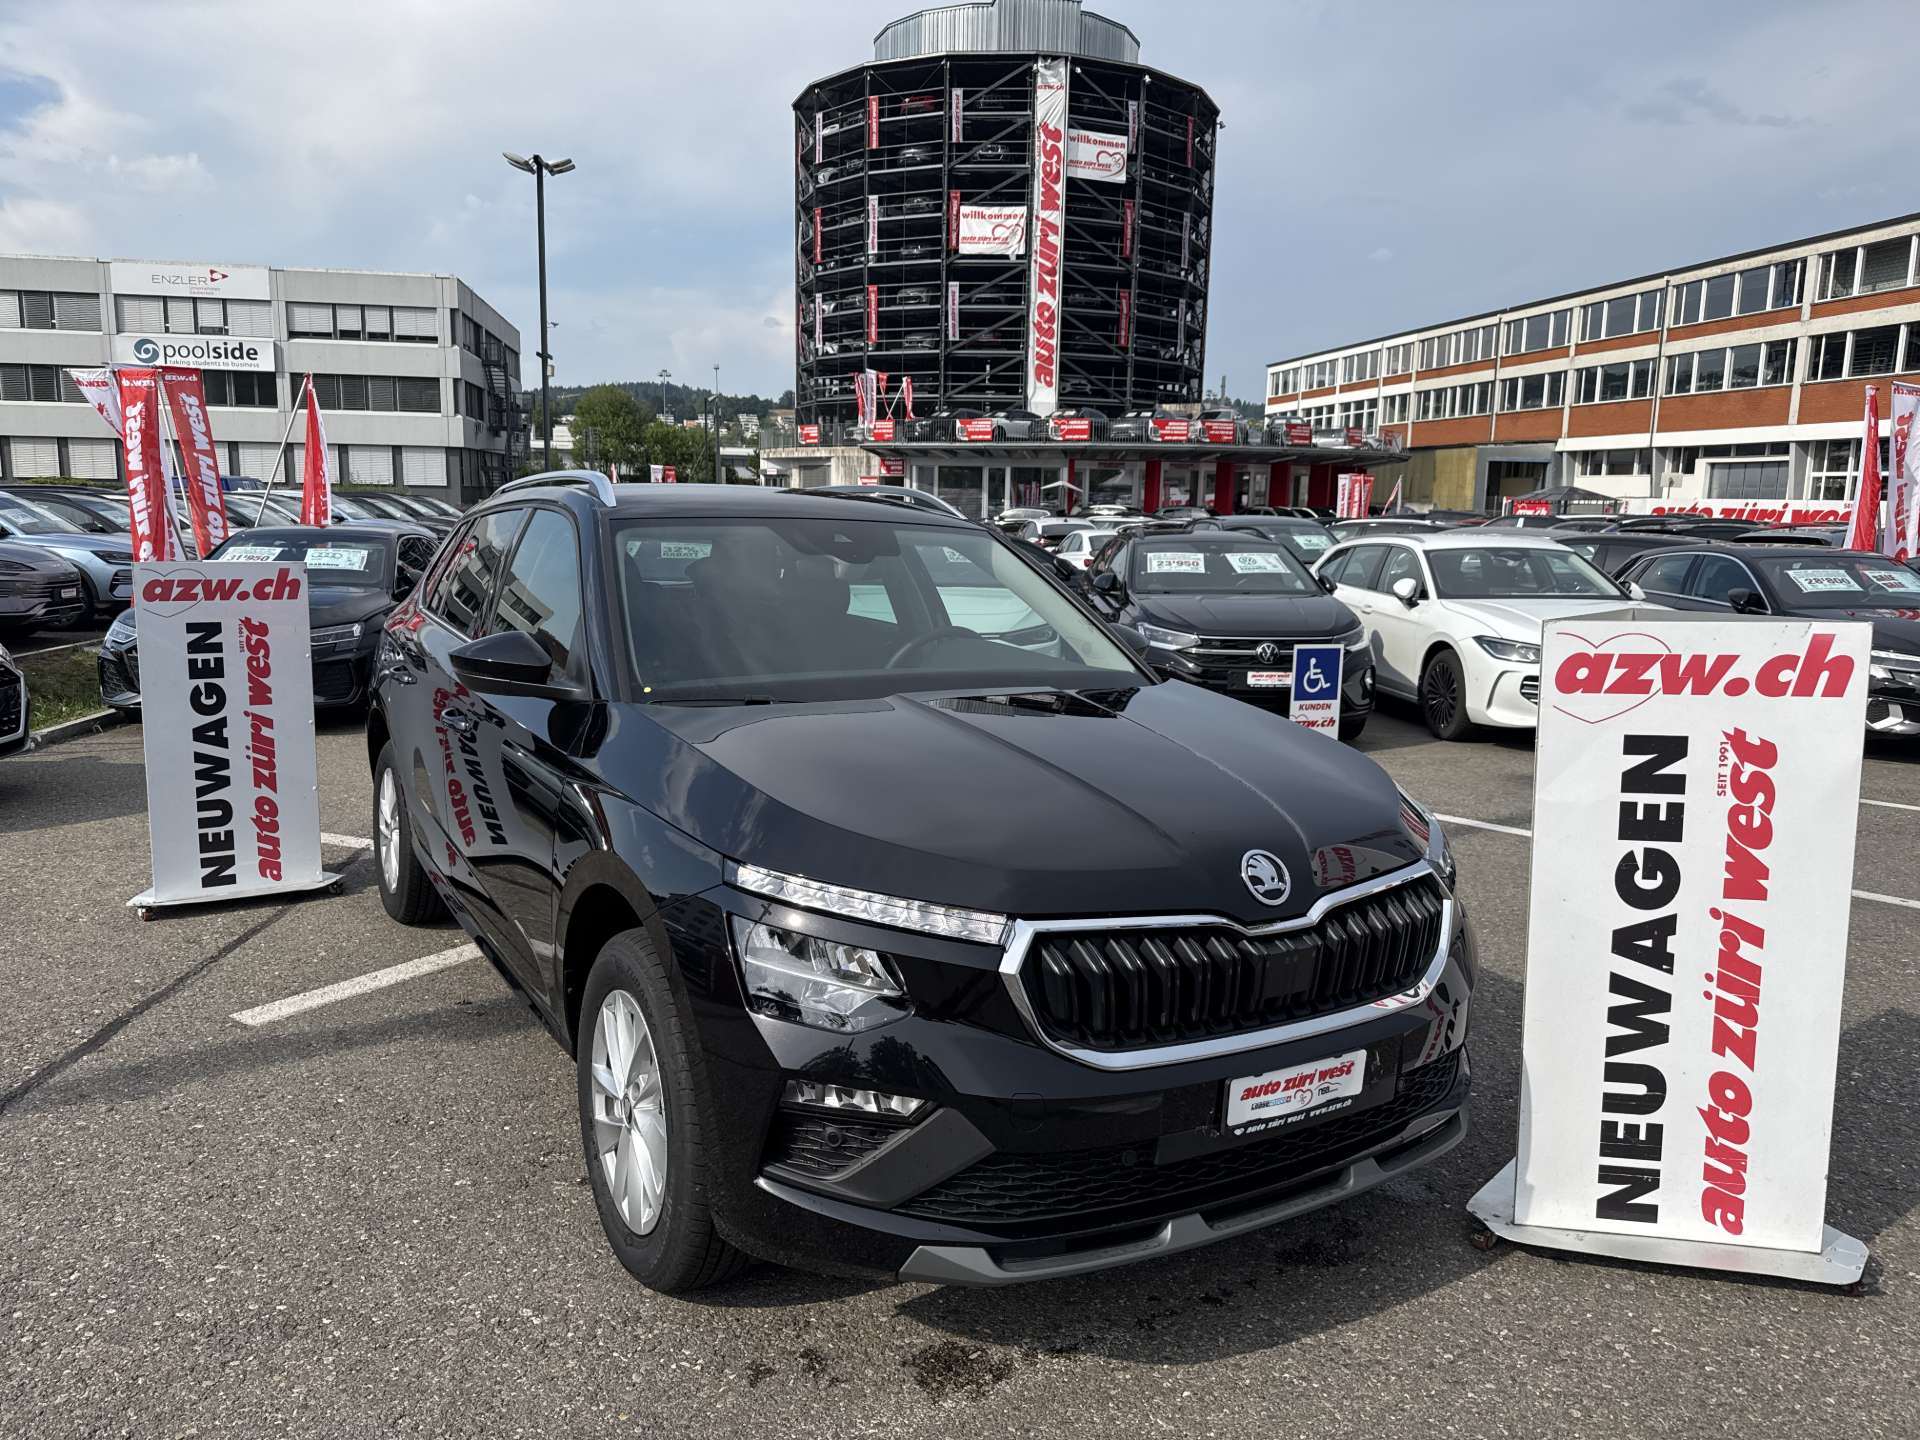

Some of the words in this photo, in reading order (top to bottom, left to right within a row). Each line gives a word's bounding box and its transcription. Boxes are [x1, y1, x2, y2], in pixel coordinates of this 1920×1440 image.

[1039, 121, 1064, 212] west
[1069, 134, 1126, 149] willkommen
[152, 274, 207, 286] ENZLER
[1035, 214, 1061, 301] züri
[163, 340, 258, 365] poolside
[1033, 302, 1057, 388] auto
[178, 391, 211, 450] west
[142, 568, 301, 602] azw.ch
[238, 616, 273, 706] west
[1554, 633, 1855, 699] azw.ch
[1298, 703, 1331, 711] KUNDEN
[185, 621, 237, 888] NEUWAGEN
[243, 710, 278, 795] züri
[1717, 772, 1727, 796] SEIT
[1719, 741, 1729, 768] 1991
[249, 795, 282, 882] auto
[1721, 727, 1779, 902] west
[1595, 734, 1690, 1224] NEUWAGEN
[1704, 907, 1766, 1073] züri
[1241, 1080, 1281, 1101] auto
[1281, 1068, 1318, 1092] züri
[1318, 1060, 1355, 1082] west
[1696, 1070, 1753, 1236] auto
